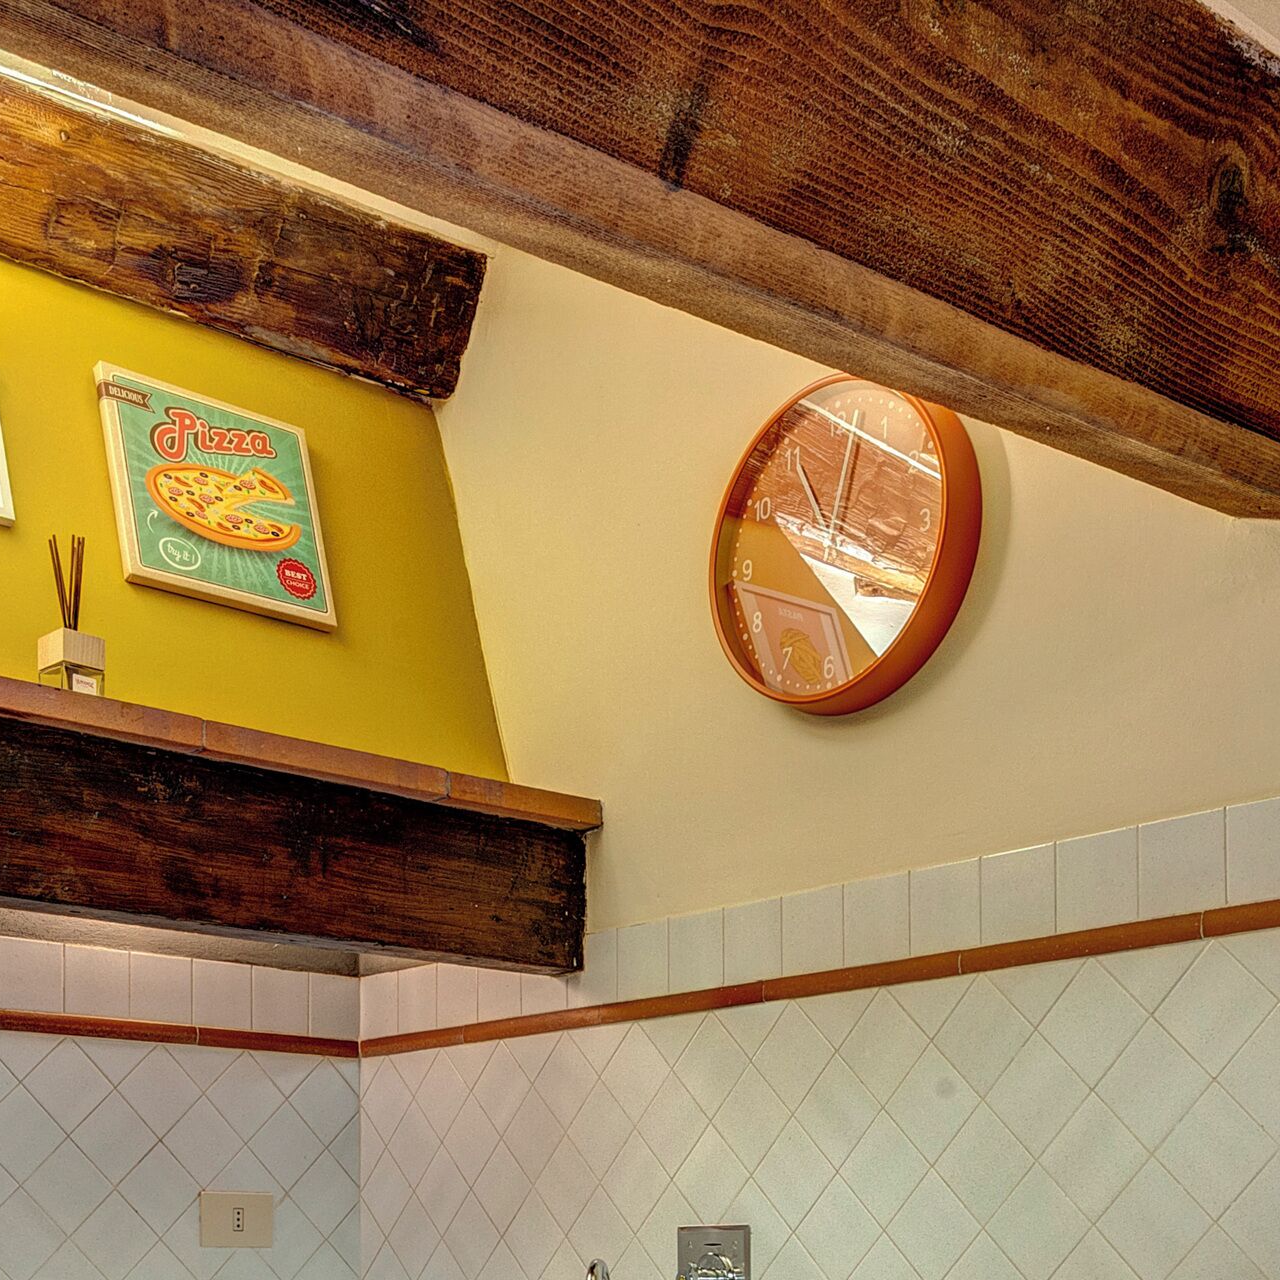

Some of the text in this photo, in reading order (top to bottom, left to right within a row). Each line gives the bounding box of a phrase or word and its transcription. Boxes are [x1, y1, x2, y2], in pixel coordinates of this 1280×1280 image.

[108, 385, 144, 404] DELICIOUS
[151, 407, 277, 463] Pizza
[880, 415, 888, 439] 1
[784, 446, 800, 471] 11
[754, 497, 771, 521] 10
[920, 508, 931, 532] 3
[284, 569, 308, 581] BEST
[742, 560, 753, 581] 9
[286, 579, 310, 590] CHOICE
[752, 611, 762, 633] 8
[782, 647, 793, 670] 7
[823, 656, 834, 679] 6
